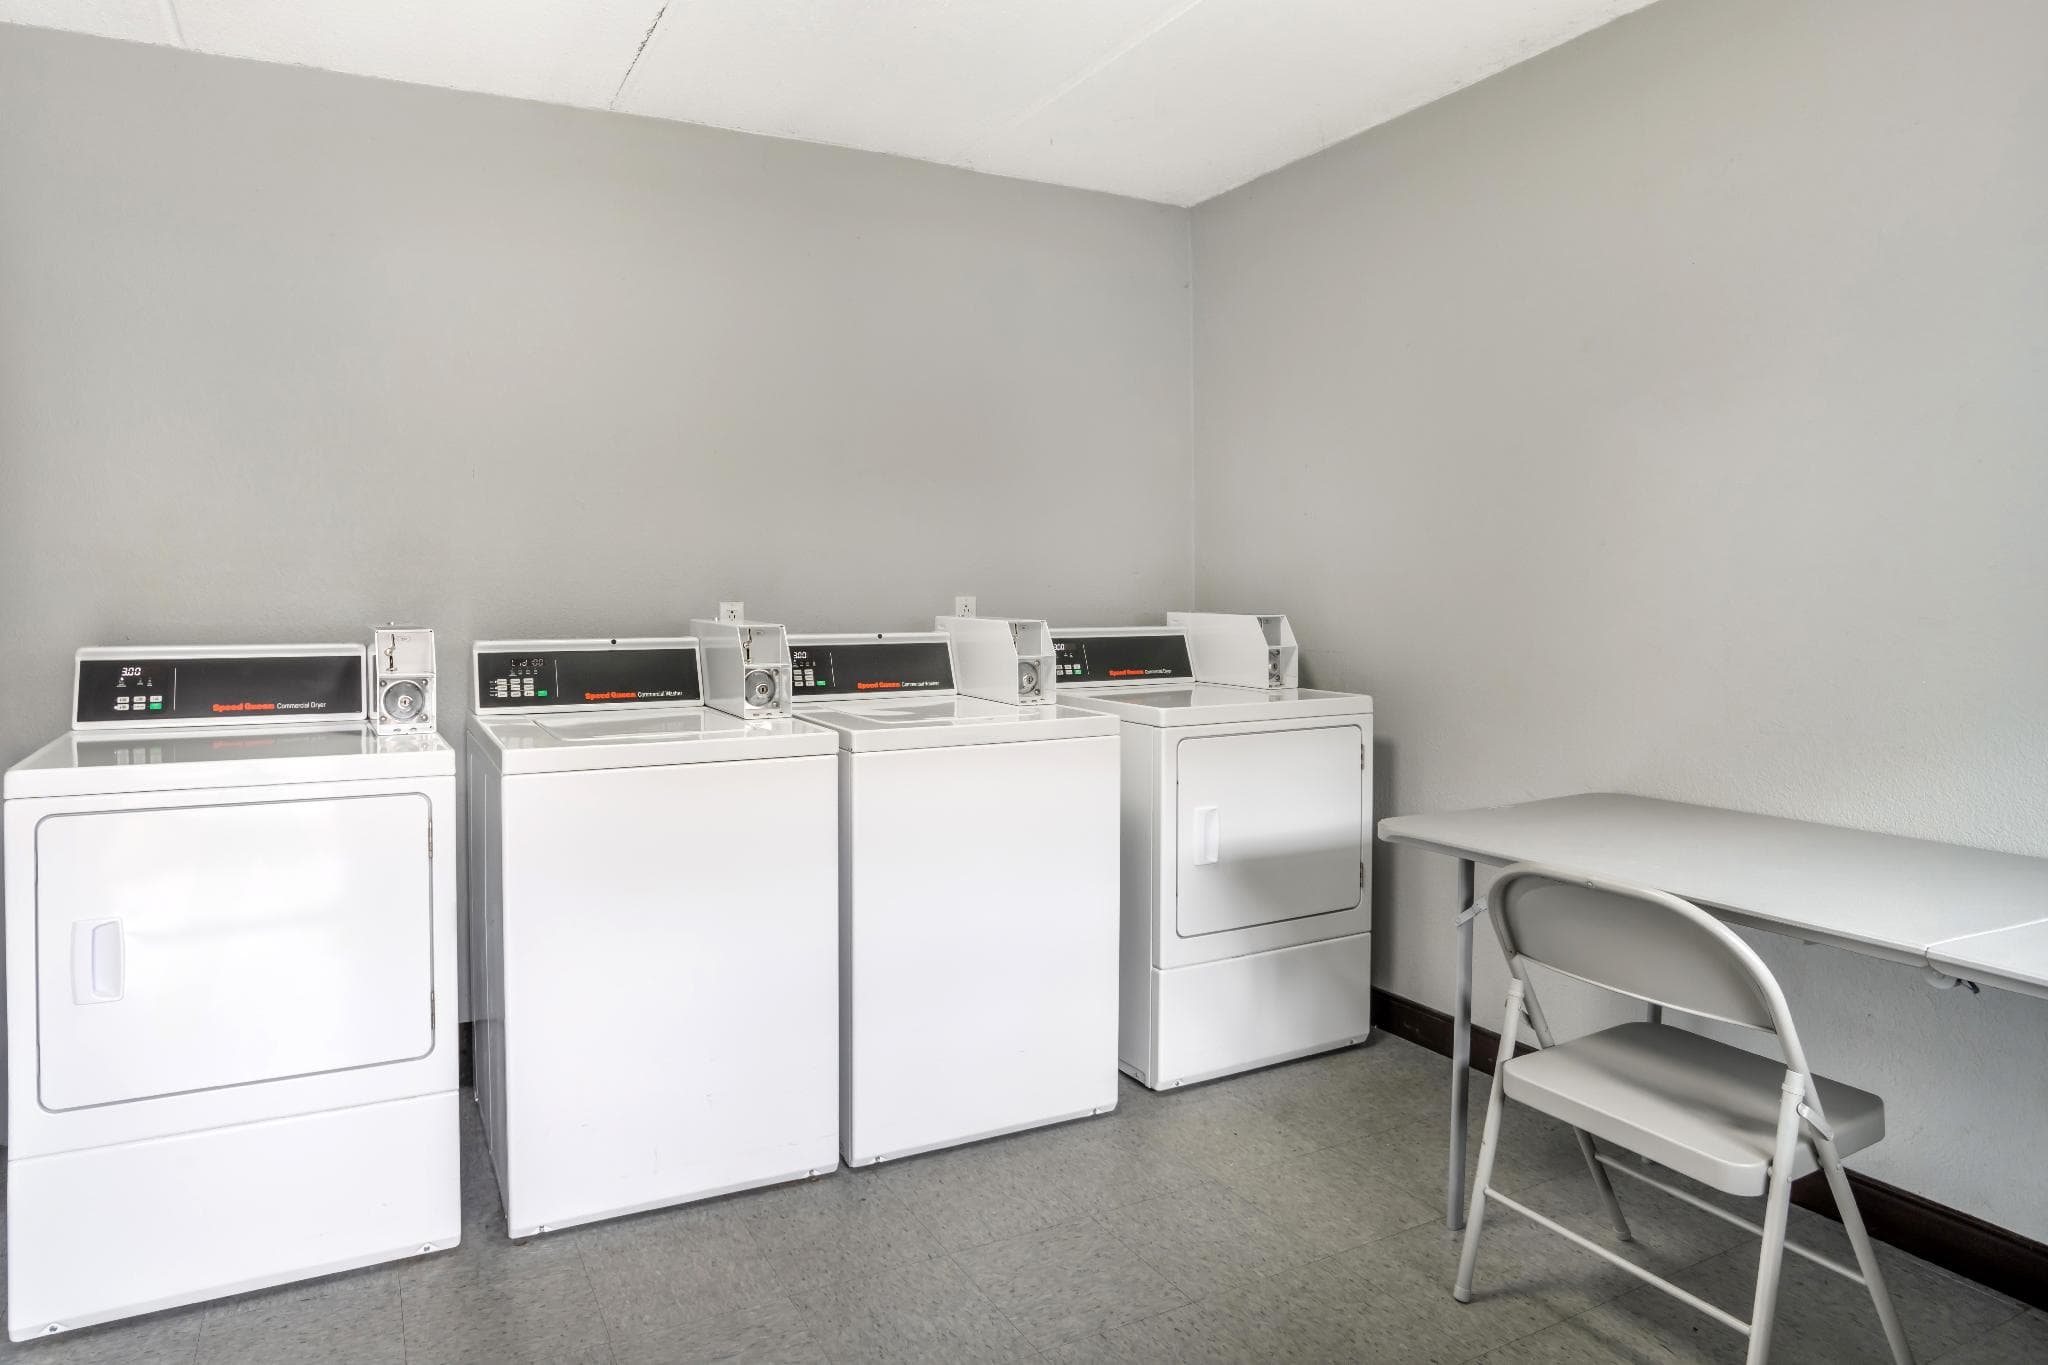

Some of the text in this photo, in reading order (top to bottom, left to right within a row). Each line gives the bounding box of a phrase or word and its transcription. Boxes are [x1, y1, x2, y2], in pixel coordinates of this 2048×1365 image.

[584, 692, 610, 700] Speed
[611, 691, 637, 699] Queen
[212, 702, 326, 712] Speed Queen Commercial Dryer
